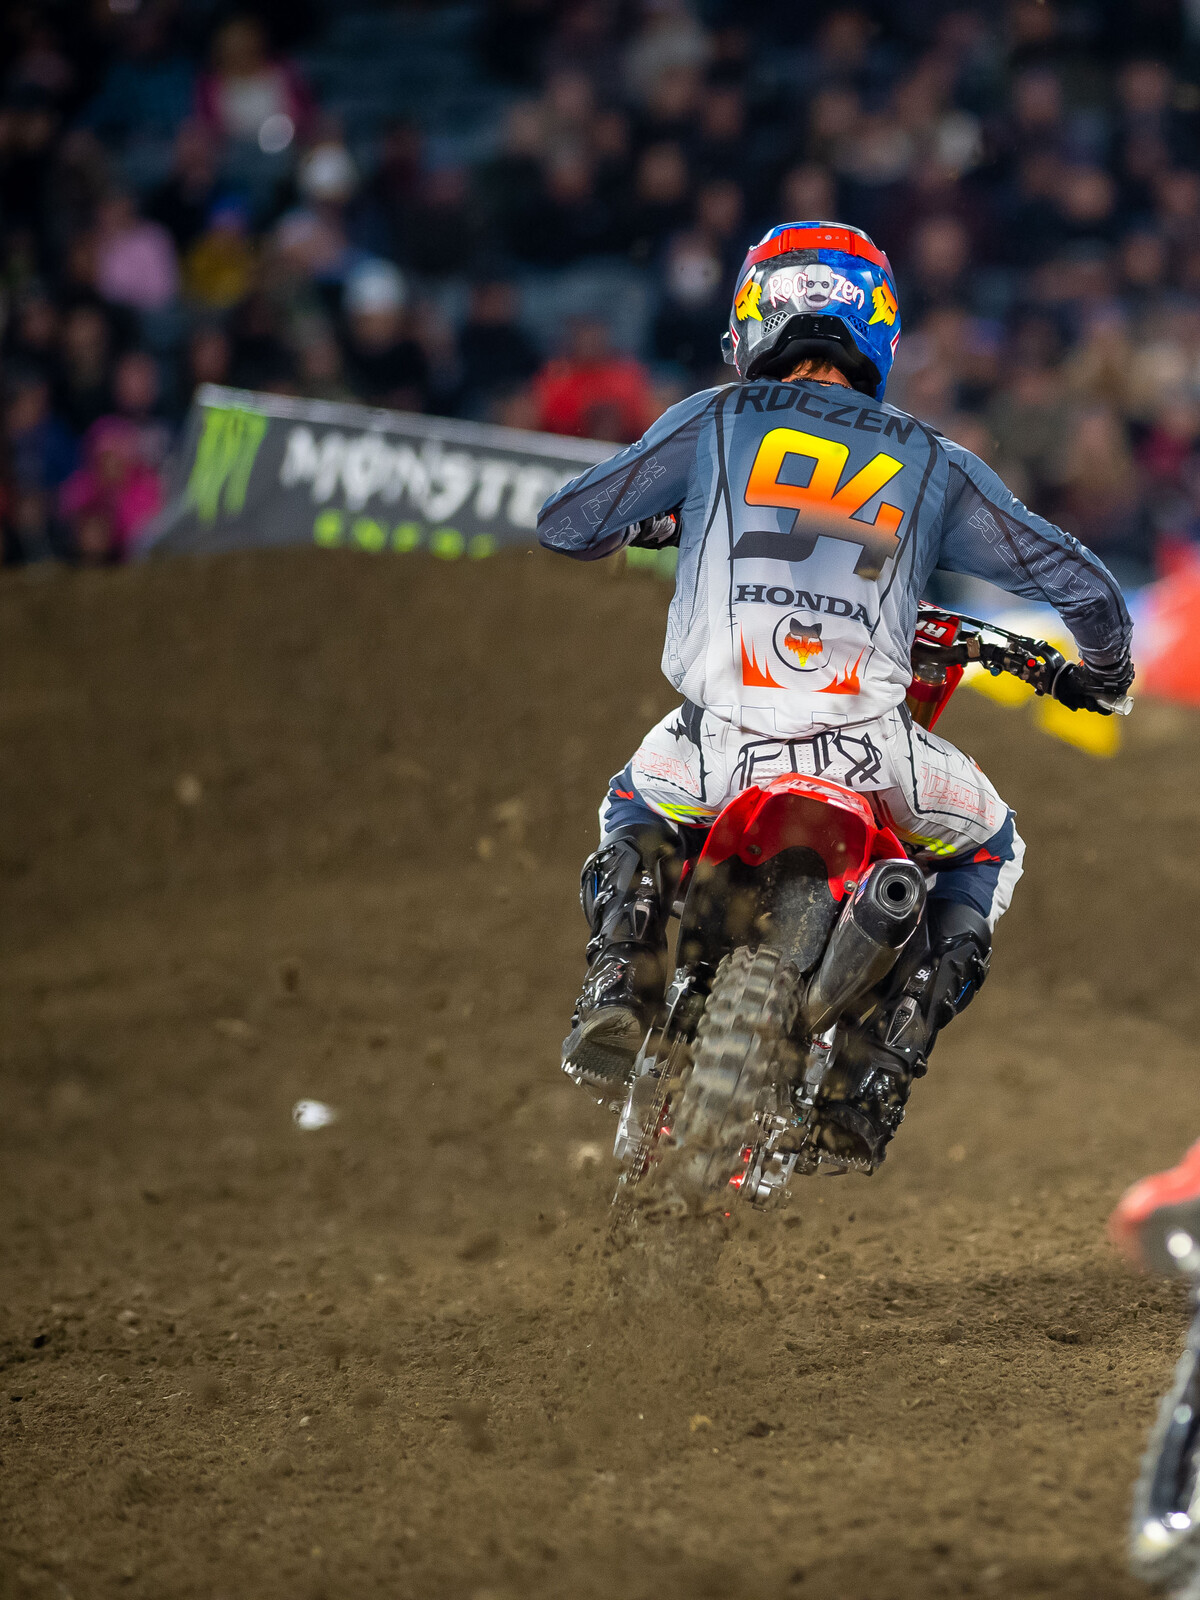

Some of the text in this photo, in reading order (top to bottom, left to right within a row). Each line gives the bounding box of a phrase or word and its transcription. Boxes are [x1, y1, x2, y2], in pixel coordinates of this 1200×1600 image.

[733, 385, 916, 445] ROCZEN
[279, 426, 577, 529] MONSTE
[727, 427, 905, 581] 94
[735, 584, 873, 629] HONDA
[640, 876, 654, 887] 94
[914, 968, 930, 982] 94
